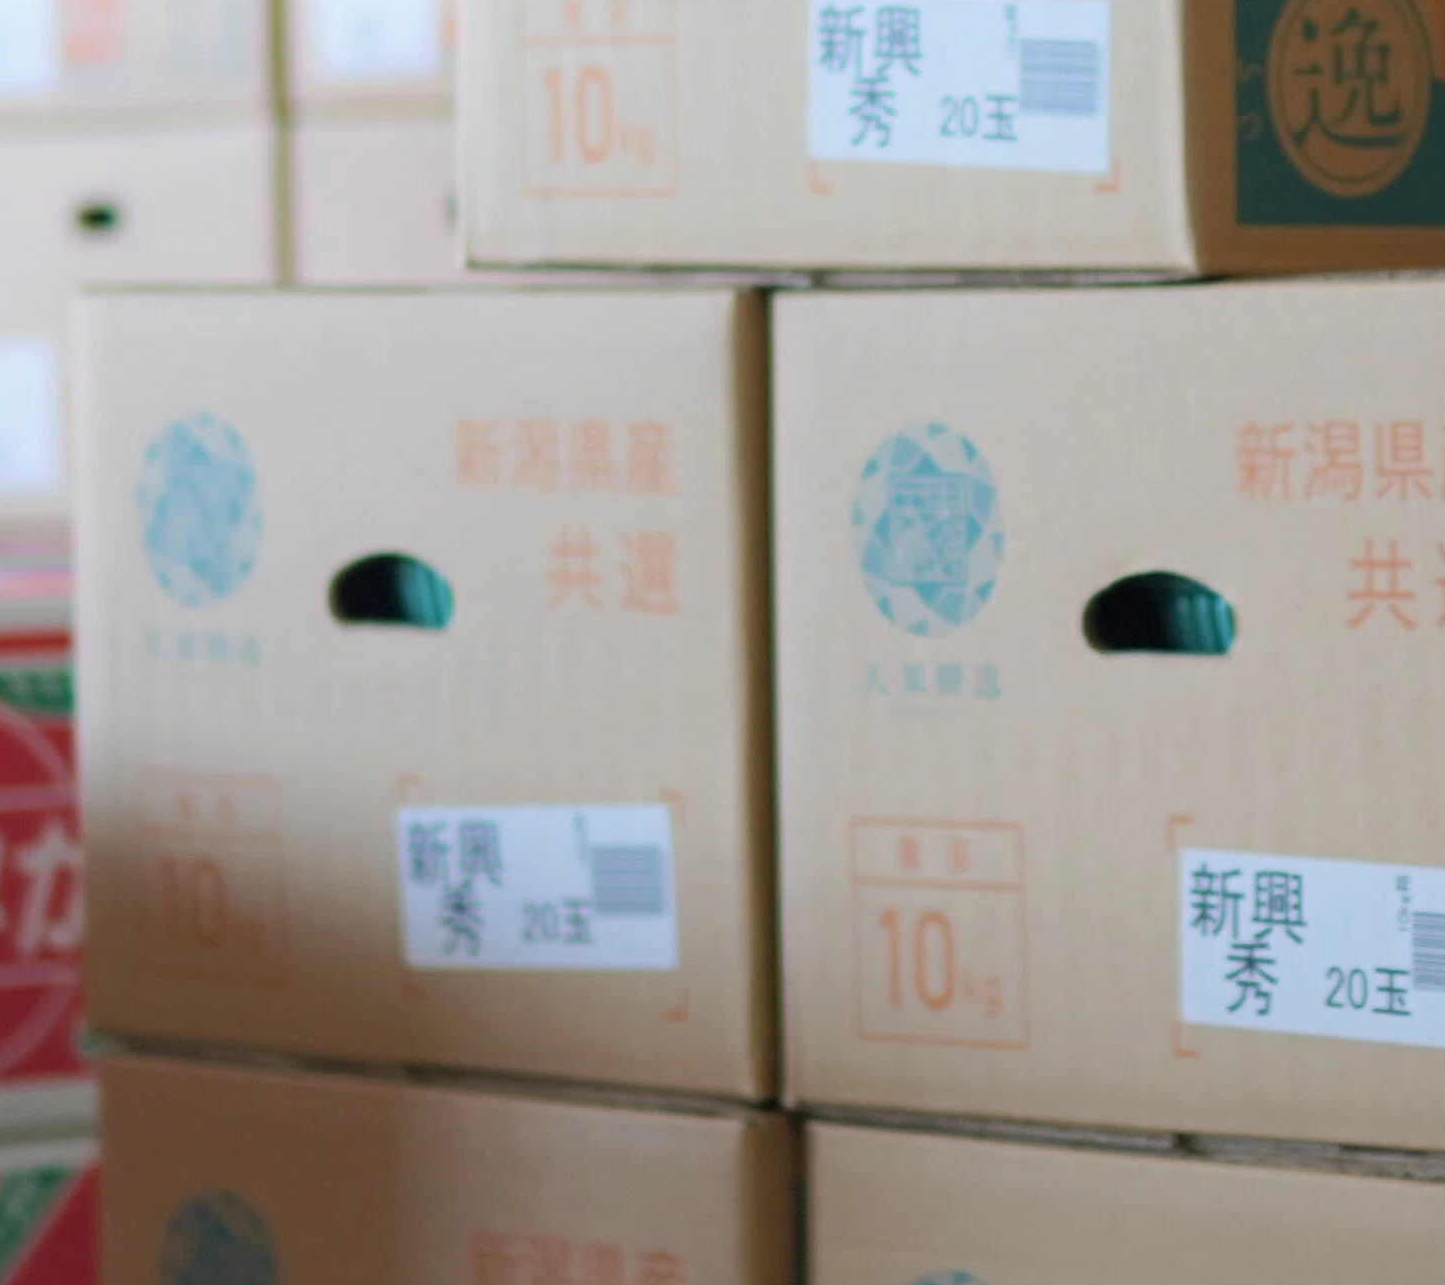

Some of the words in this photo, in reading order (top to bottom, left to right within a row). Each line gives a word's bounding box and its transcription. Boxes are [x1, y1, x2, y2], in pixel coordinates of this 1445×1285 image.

[816, 4, 923, 77] 新興
[848, 71, 897, 148] 秀
[939, 94, 1019, 143] 20玉
[1292, 8, 1409, 151] 逸
[1187, 861, 1307, 944] 新興
[1225, 941, 1280, 1016] 秀
[1325, 966, 1413, 1018] 20玉
